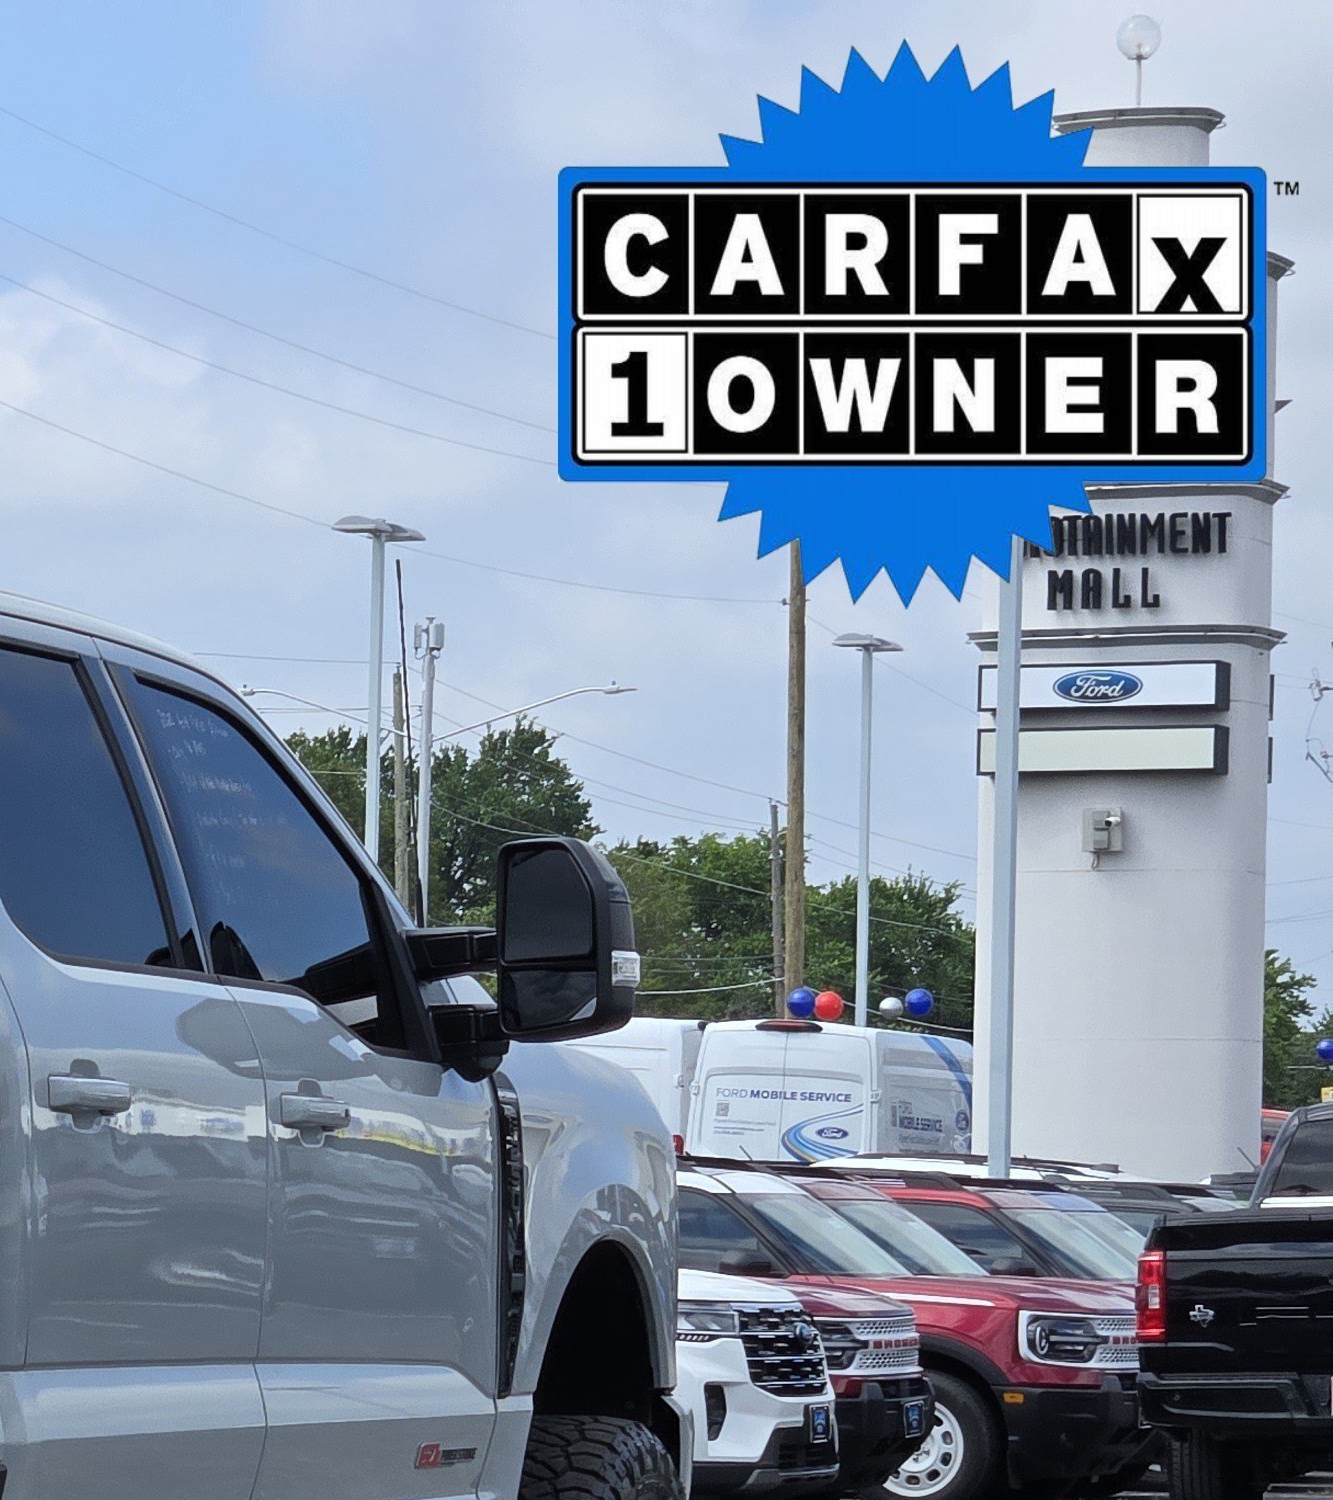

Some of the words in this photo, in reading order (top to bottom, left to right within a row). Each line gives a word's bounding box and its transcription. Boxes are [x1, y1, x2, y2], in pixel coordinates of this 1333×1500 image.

[1047, 567, 1160, 610] MALL
[1070, 675, 1124, 698] Ford
[716, 1088, 748, 1099] FORD
[750, 1090, 797, 1101] MOBILE
[800, 1092, 852, 1103] SERVICE
